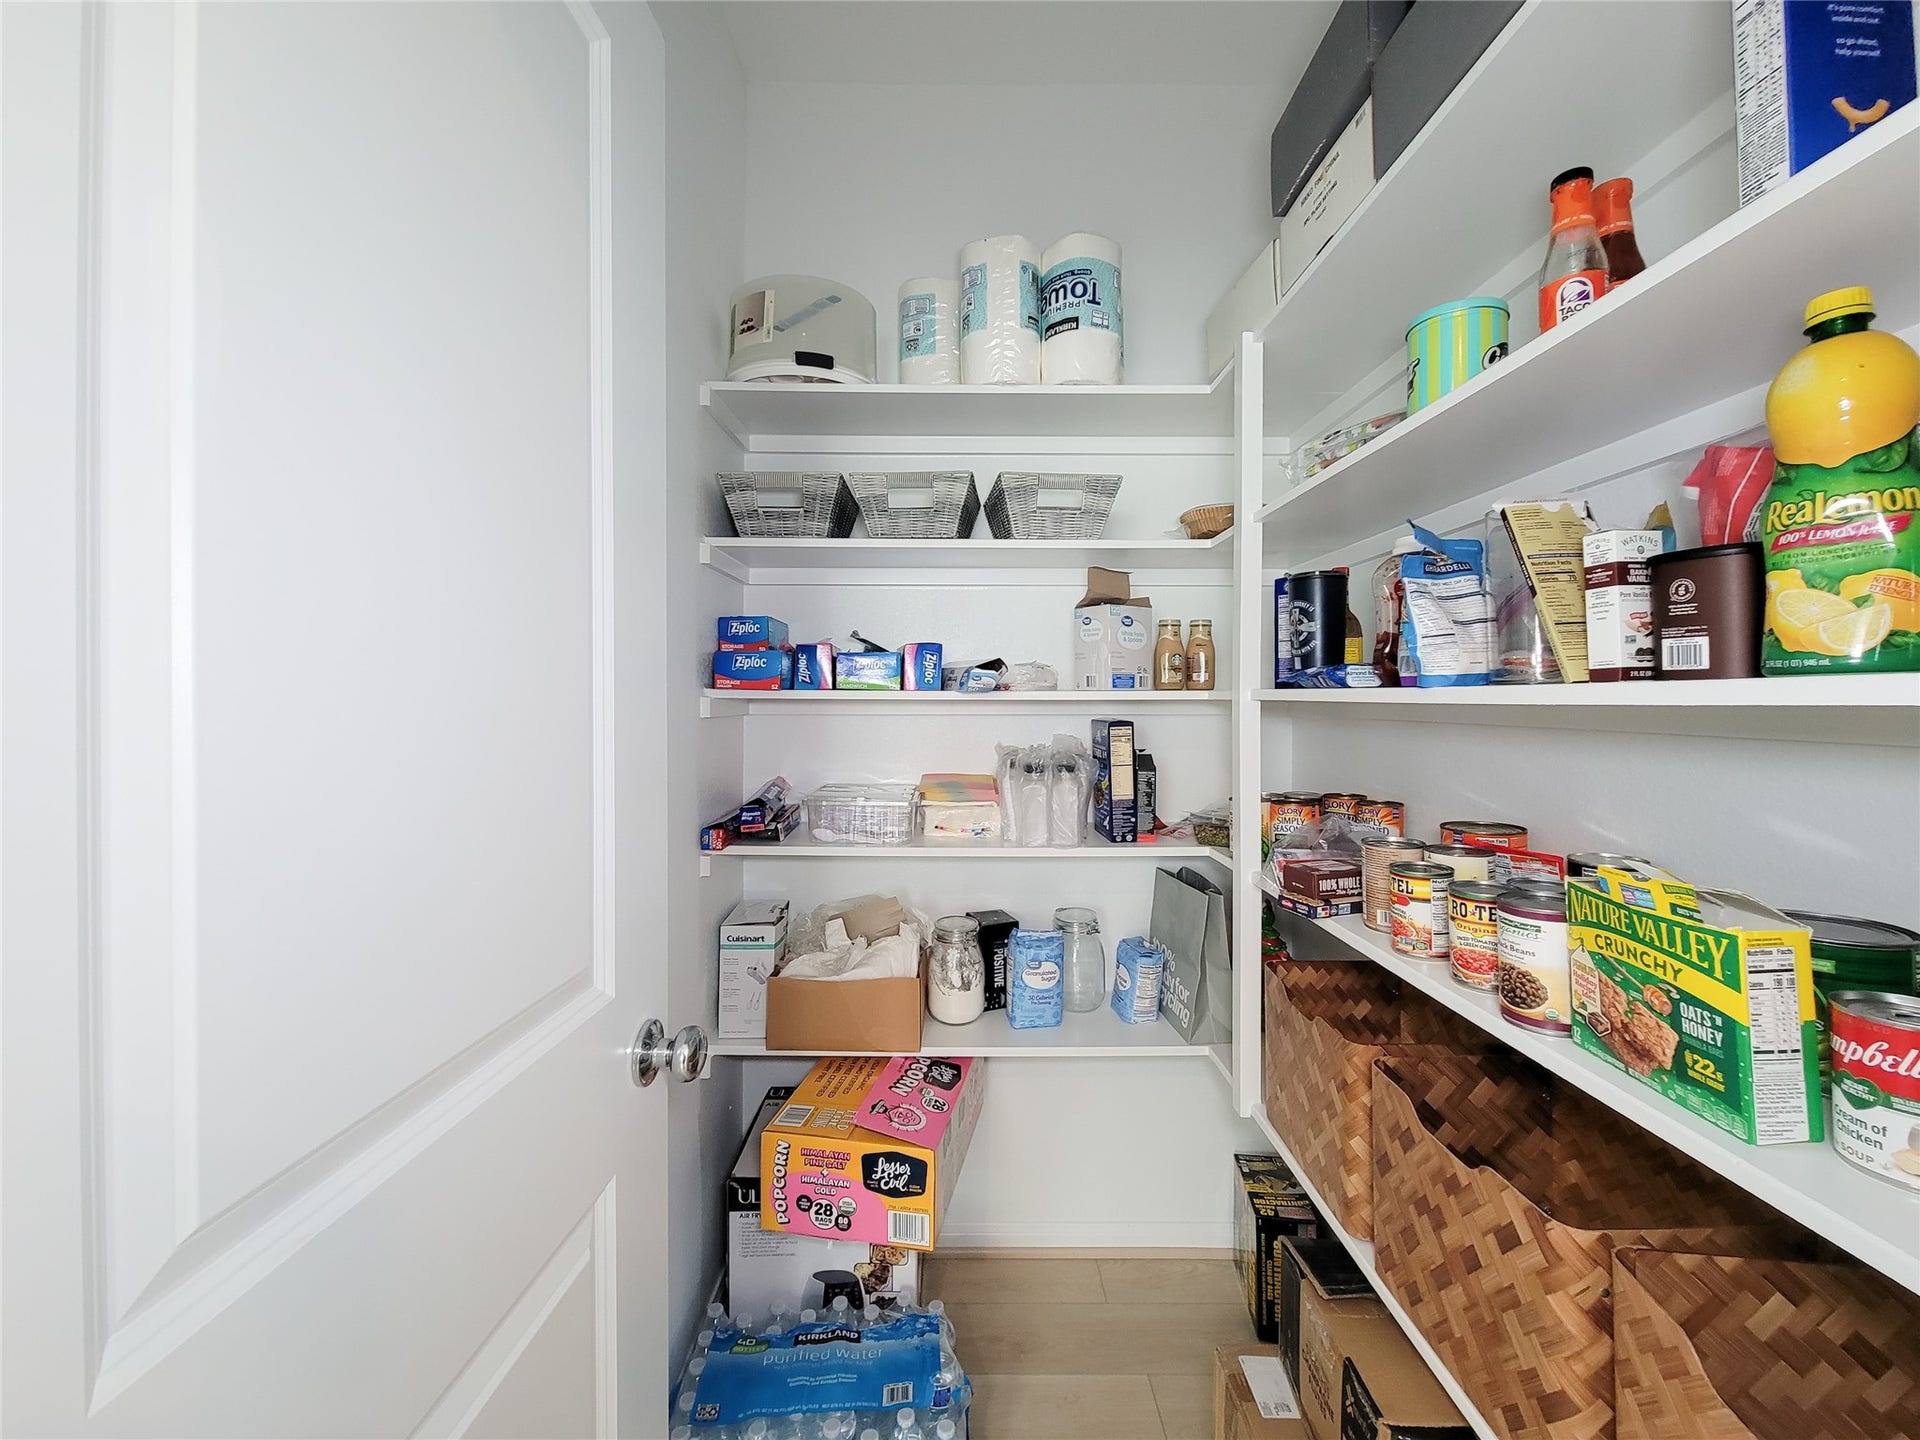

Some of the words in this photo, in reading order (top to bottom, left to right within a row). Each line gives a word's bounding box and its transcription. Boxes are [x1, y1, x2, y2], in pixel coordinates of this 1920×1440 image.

[1765, 486, 1920, 535] ReaLemon
[1620, 534, 1660, 547] WATKINS
[730, 621, 761, 636] Ziploc
[735, 655, 767, 671] Ziploc
[798, 653, 811, 684] Ziploc
[923, 653, 937, 685] Ziploc
[1802, 658, 1818, 666] 946
[1277, 807, 1304, 816] GLORY
[1276, 816, 1306, 826] SIMPLY
[1319, 879, 1338, 892] 100%
[1338, 877, 1361, 890] WHOLE
[726, 935, 766, 943] Cuisinart
[1569, 887, 1633, 935] NATURE
[1631, 913, 1730, 982] VALLEY
[1509, 944, 1536, 958] Beans
[1593, 933, 1684, 983] CRUNCHY
[993, 948, 1005, 988] POSITIVE
[1174, 976, 1190, 1004] for
[1679, 1001, 1712, 1026] OATS
[1682, 1018, 1724, 1048] HONEY
[1843, 1077, 1870, 1091] HEART
[1840, 1082, 1878, 1102] HEALTHY
[932, 1099, 947, 1112] 28
[1835, 1103, 1868, 1130] Cream
[1871, 1124, 1888, 1137] of
[1836, 1118, 1884, 1151] Chicken
[800, 1147, 852, 1161] HIMALAYAN
[1840, 1140, 1875, 1163] SOUP
[803, 1158, 825, 1168] PINK
[825, 1160, 848, 1171] SALT
[871, 1156, 912, 1180] Lesser
[772, 1138, 792, 1225] POPCORN
[800, 1174, 851, 1189] HIMALAYAN
[879, 1170, 909, 1192] Evil
[814, 1186, 838, 1197] GOLD
[813, 1201, 835, 1218] 28
[1253, 1198, 1310, 1206] CONTRACTOR
[814, 1216, 833, 1224] BAGS
[737, 1338, 757, 1346] 40
[797, 1330, 860, 1342] KIRKLAND
